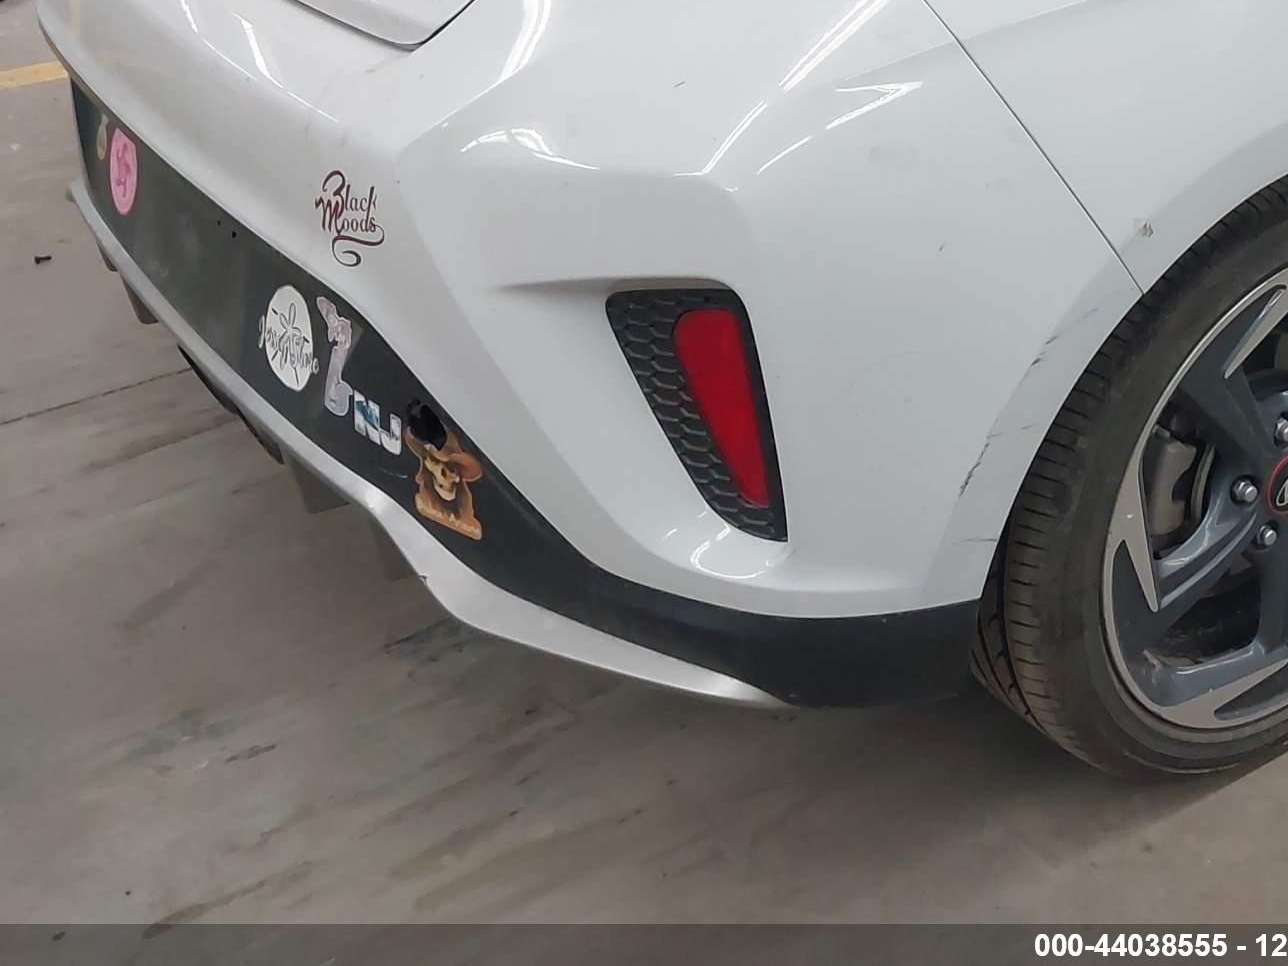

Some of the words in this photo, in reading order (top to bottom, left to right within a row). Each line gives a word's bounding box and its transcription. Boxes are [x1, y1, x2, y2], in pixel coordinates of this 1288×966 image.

[322, 170, 377, 218] Black
[315, 197, 384, 246] Moods
[354, 390, 402, 455] NJ
